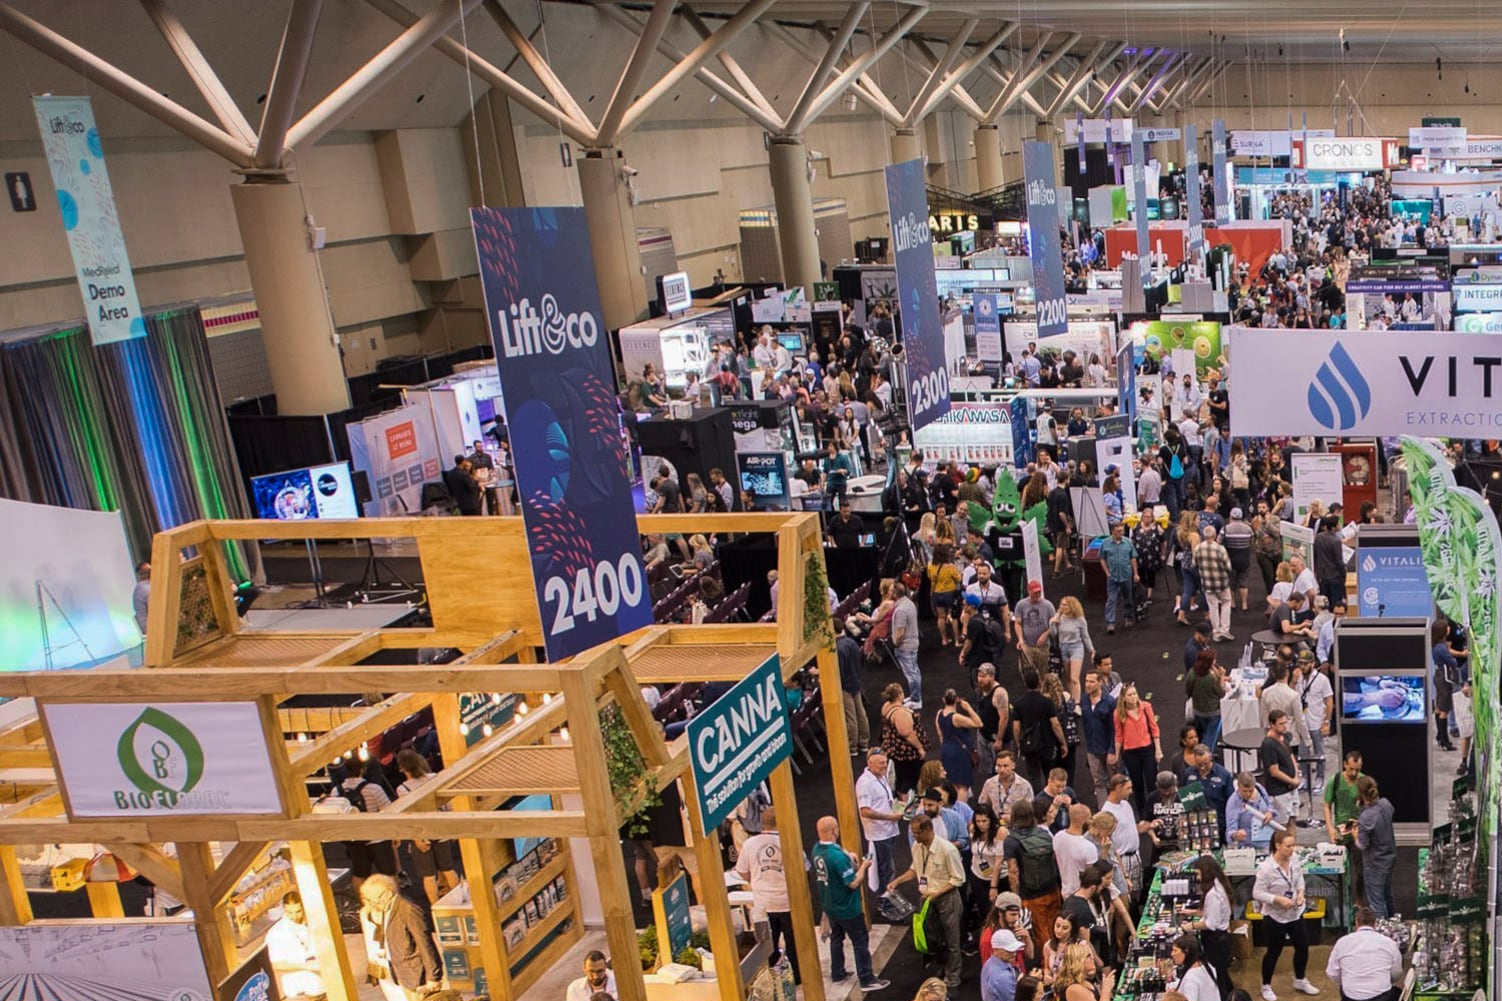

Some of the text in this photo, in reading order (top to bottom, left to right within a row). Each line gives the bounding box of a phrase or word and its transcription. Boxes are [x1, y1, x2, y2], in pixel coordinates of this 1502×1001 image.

[1312, 143, 1373, 158] CRONOS
[88, 283, 126, 301] Demo
[98, 303, 129, 322] Area
[497, 293, 599, 359] Lift&co
[1037, 297, 1067, 328] 2200
[912, 366, 949, 417] 2300
[1379, 556, 1421, 566] VITALI
[543, 551, 644, 637] 2400
[696, 671, 781, 775] CANNA
